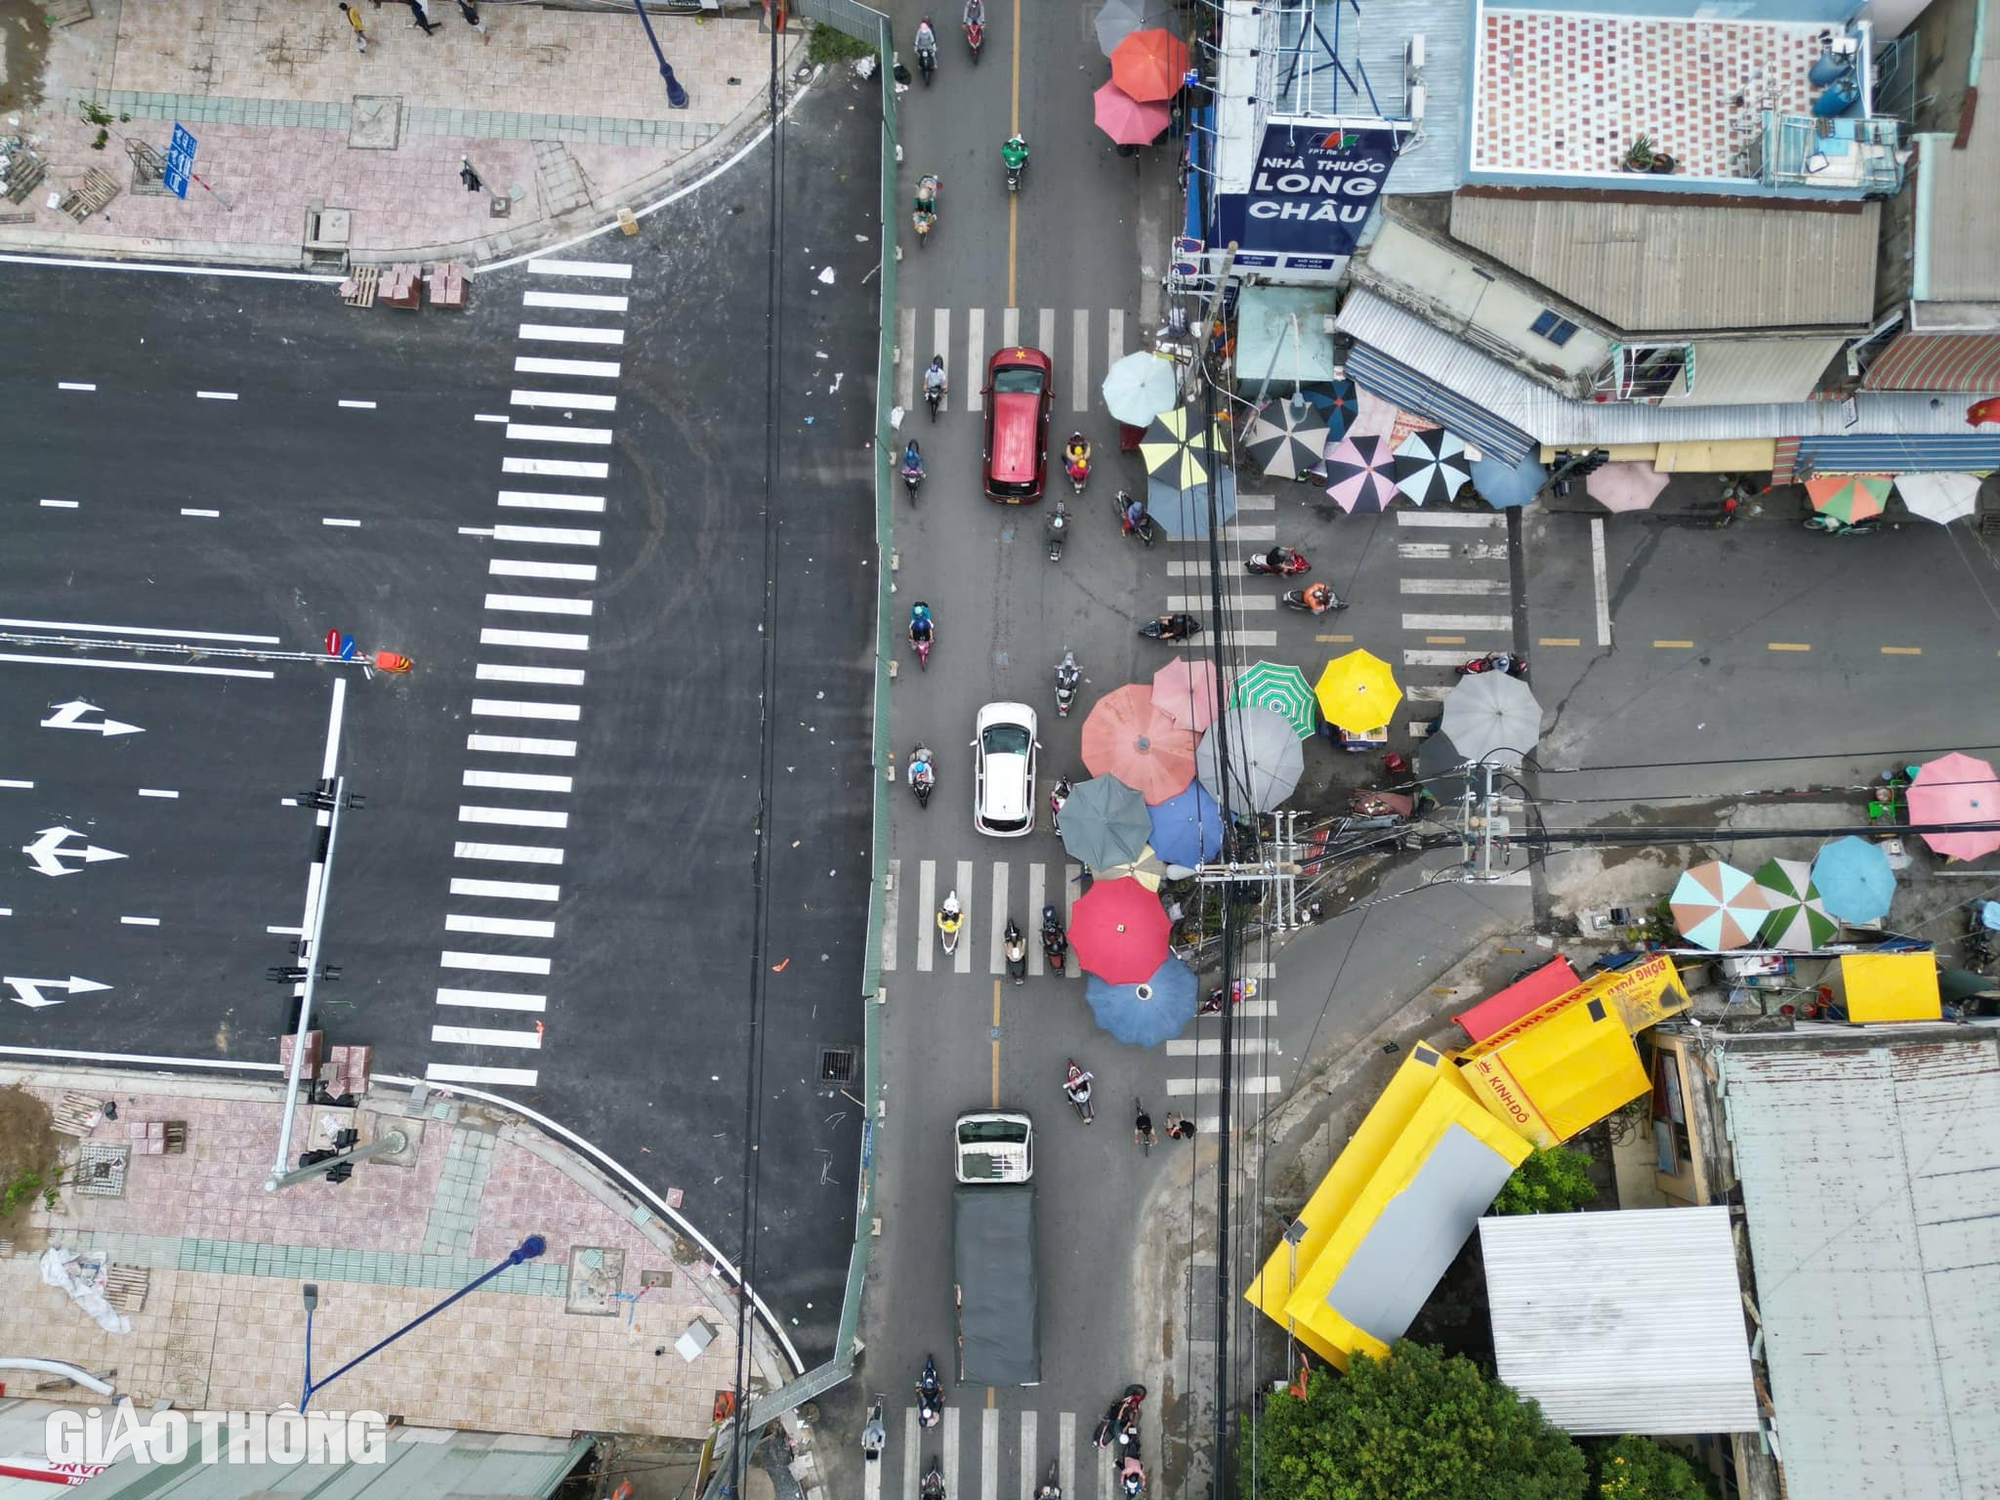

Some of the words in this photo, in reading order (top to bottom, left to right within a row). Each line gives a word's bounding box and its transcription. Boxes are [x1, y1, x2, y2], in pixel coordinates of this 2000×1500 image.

[1262, 156, 1305, 169] NHÀ
[1317, 158, 1386, 173] THUỐC
[1255, 172, 1377, 196] LONG
[1248, 199, 1368, 223] CHÂU
